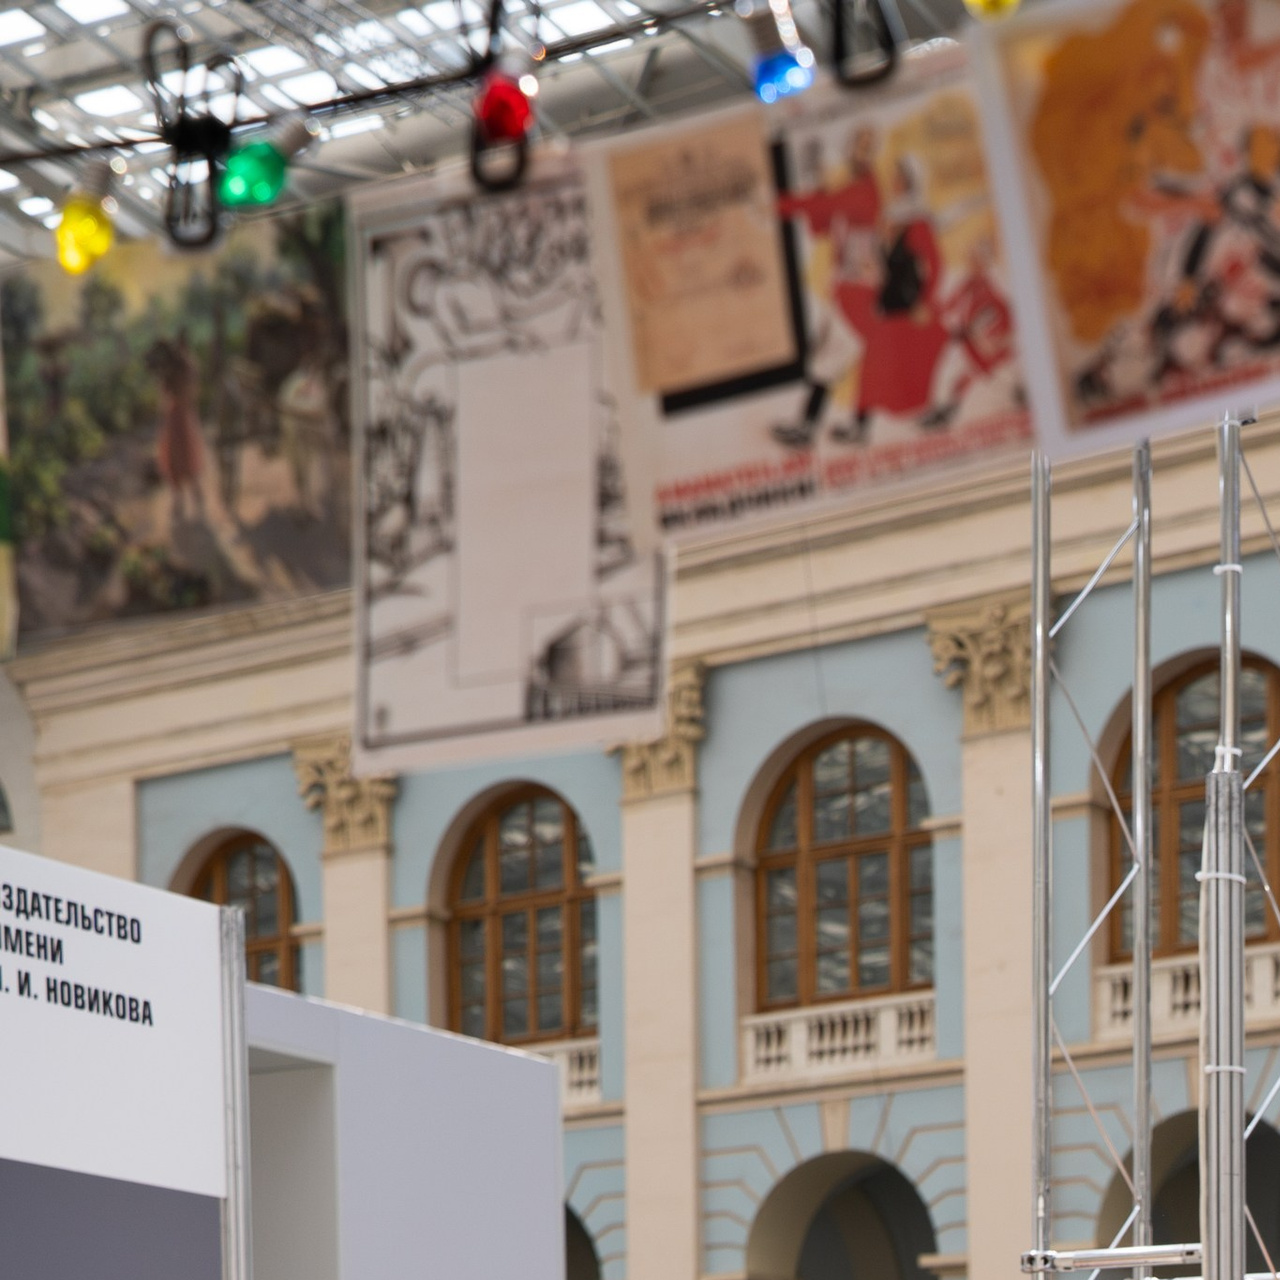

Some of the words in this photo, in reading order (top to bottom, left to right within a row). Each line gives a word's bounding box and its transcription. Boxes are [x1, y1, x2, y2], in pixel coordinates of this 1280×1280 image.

[1, 883, 142, 945] ЗДАТЕЛЬСТВО
[17, 969, 39, 1000] И.
[45, 976, 154, 1027] НОВИКОВА
